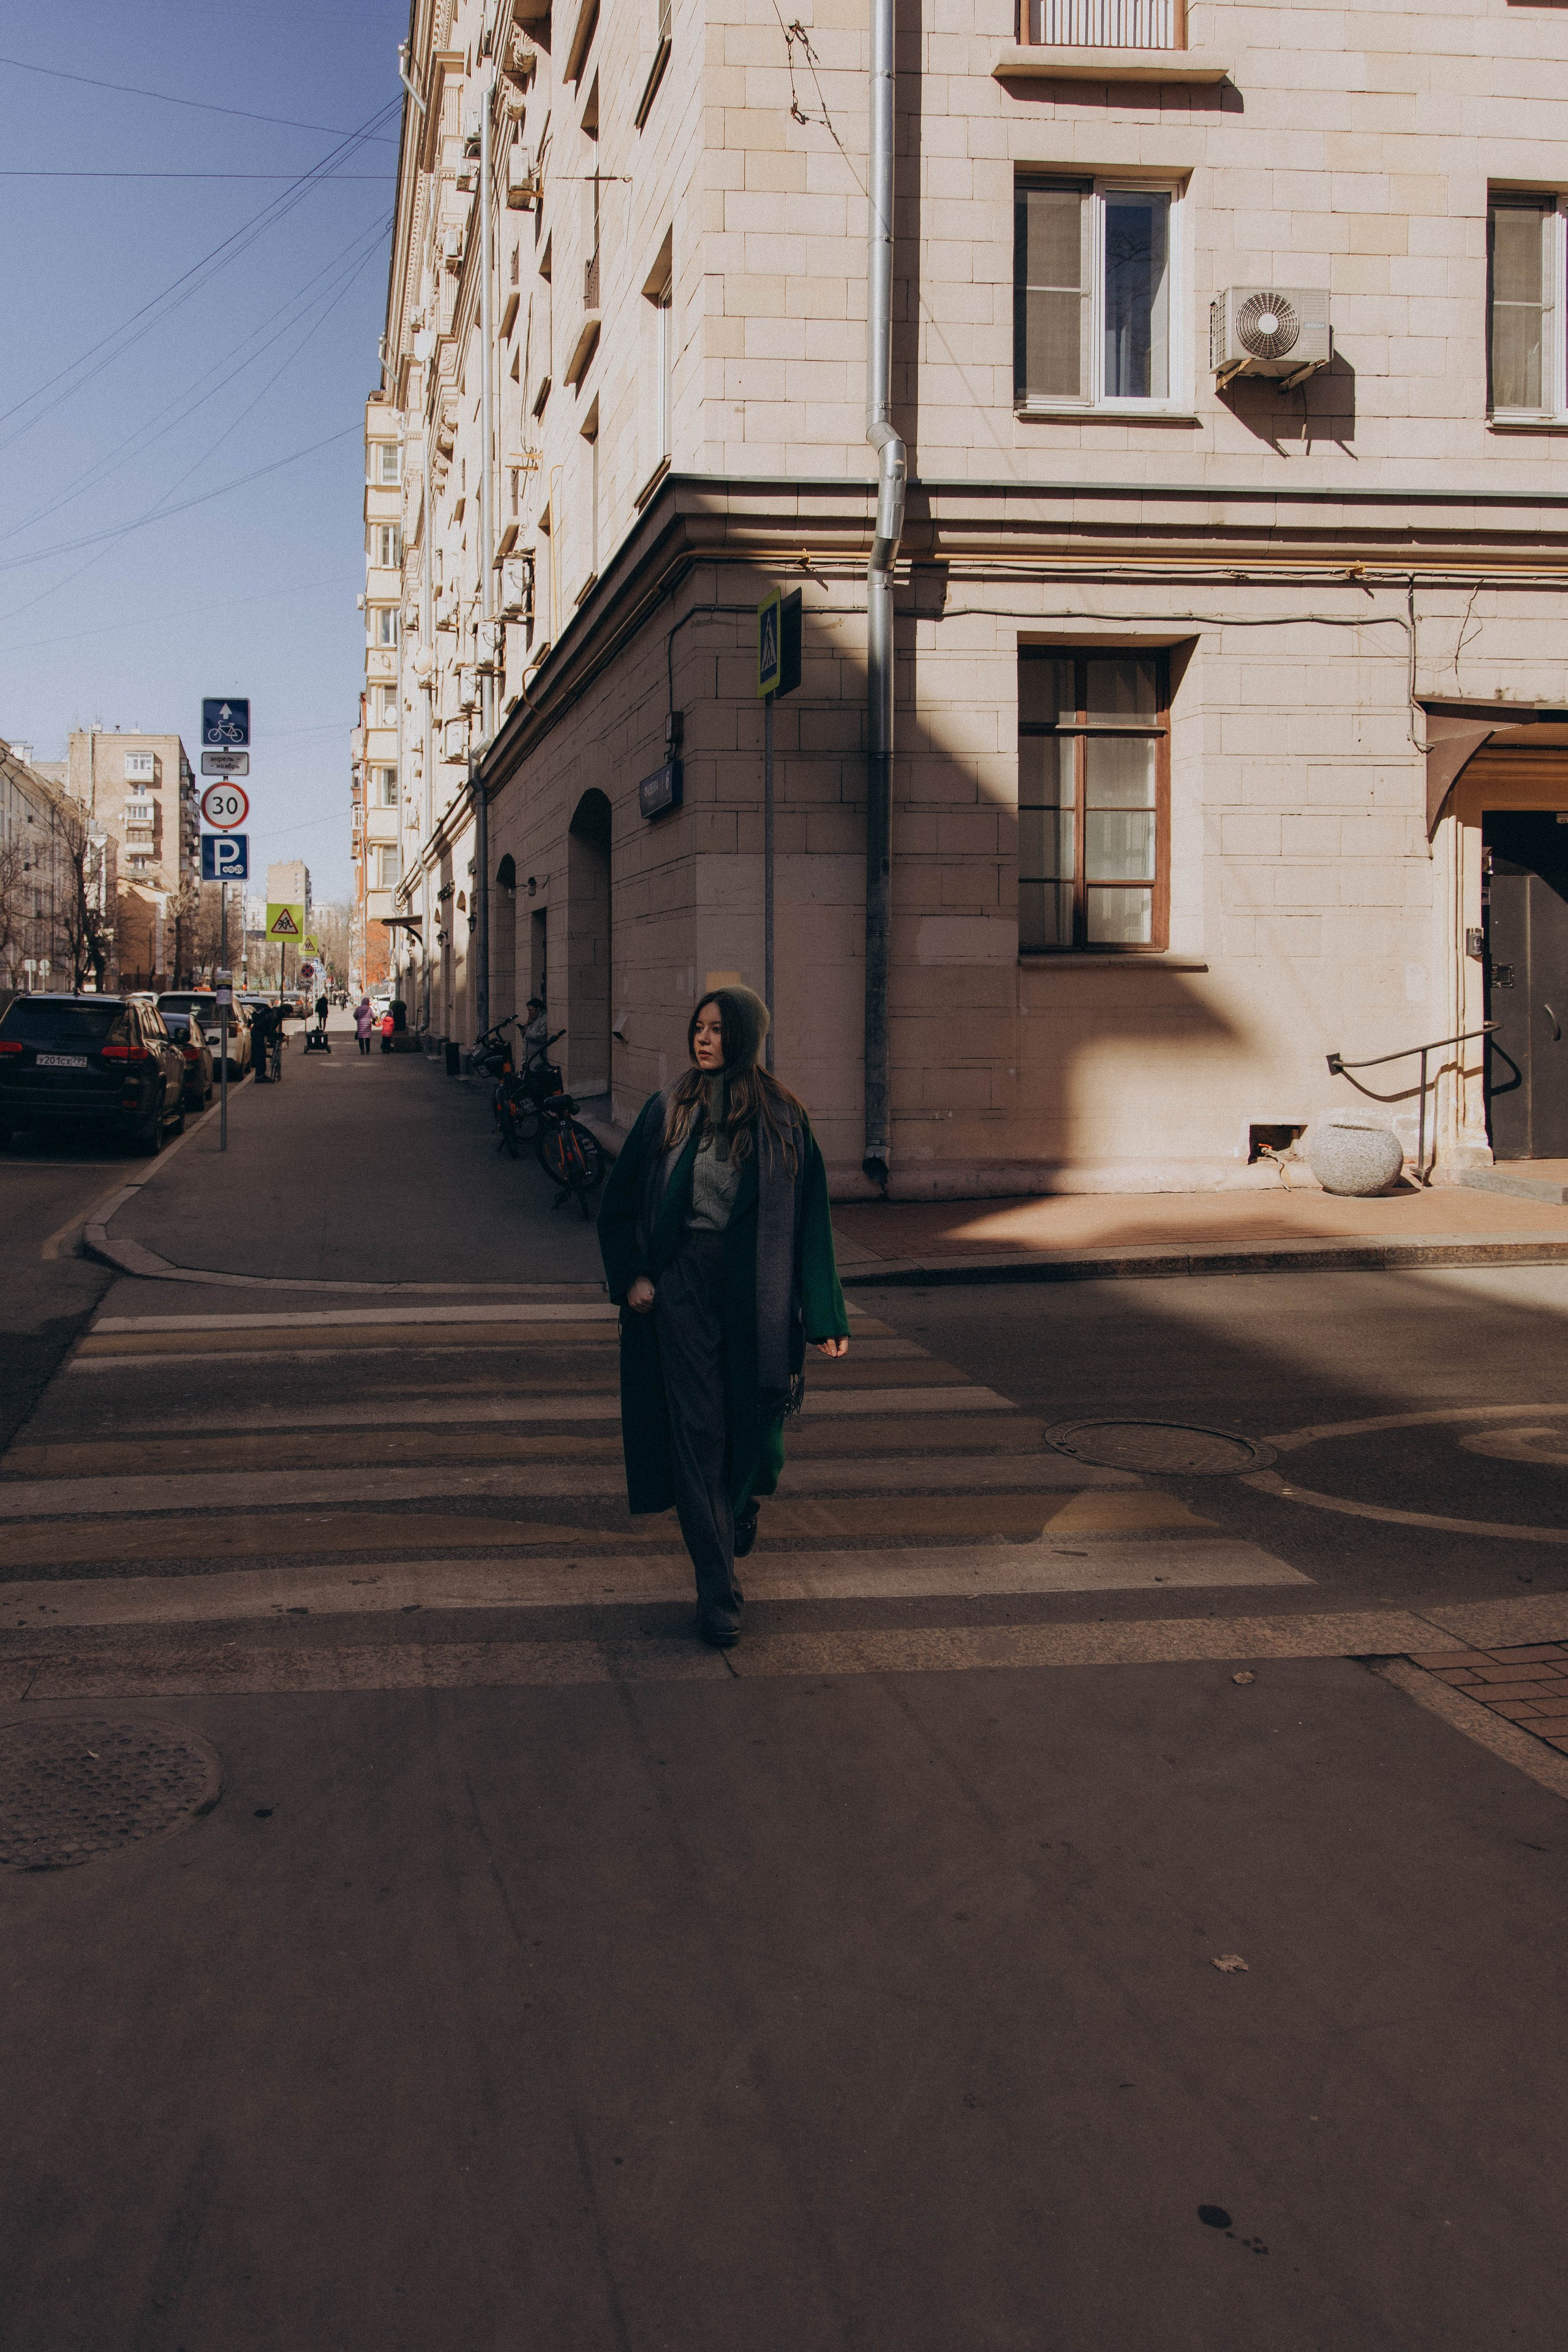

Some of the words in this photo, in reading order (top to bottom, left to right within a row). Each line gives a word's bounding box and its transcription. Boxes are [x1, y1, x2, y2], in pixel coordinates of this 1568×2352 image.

[665, 771, 669, 790] 6
[213, 796, 238, 815] 30
[214, 839, 240, 876] P
